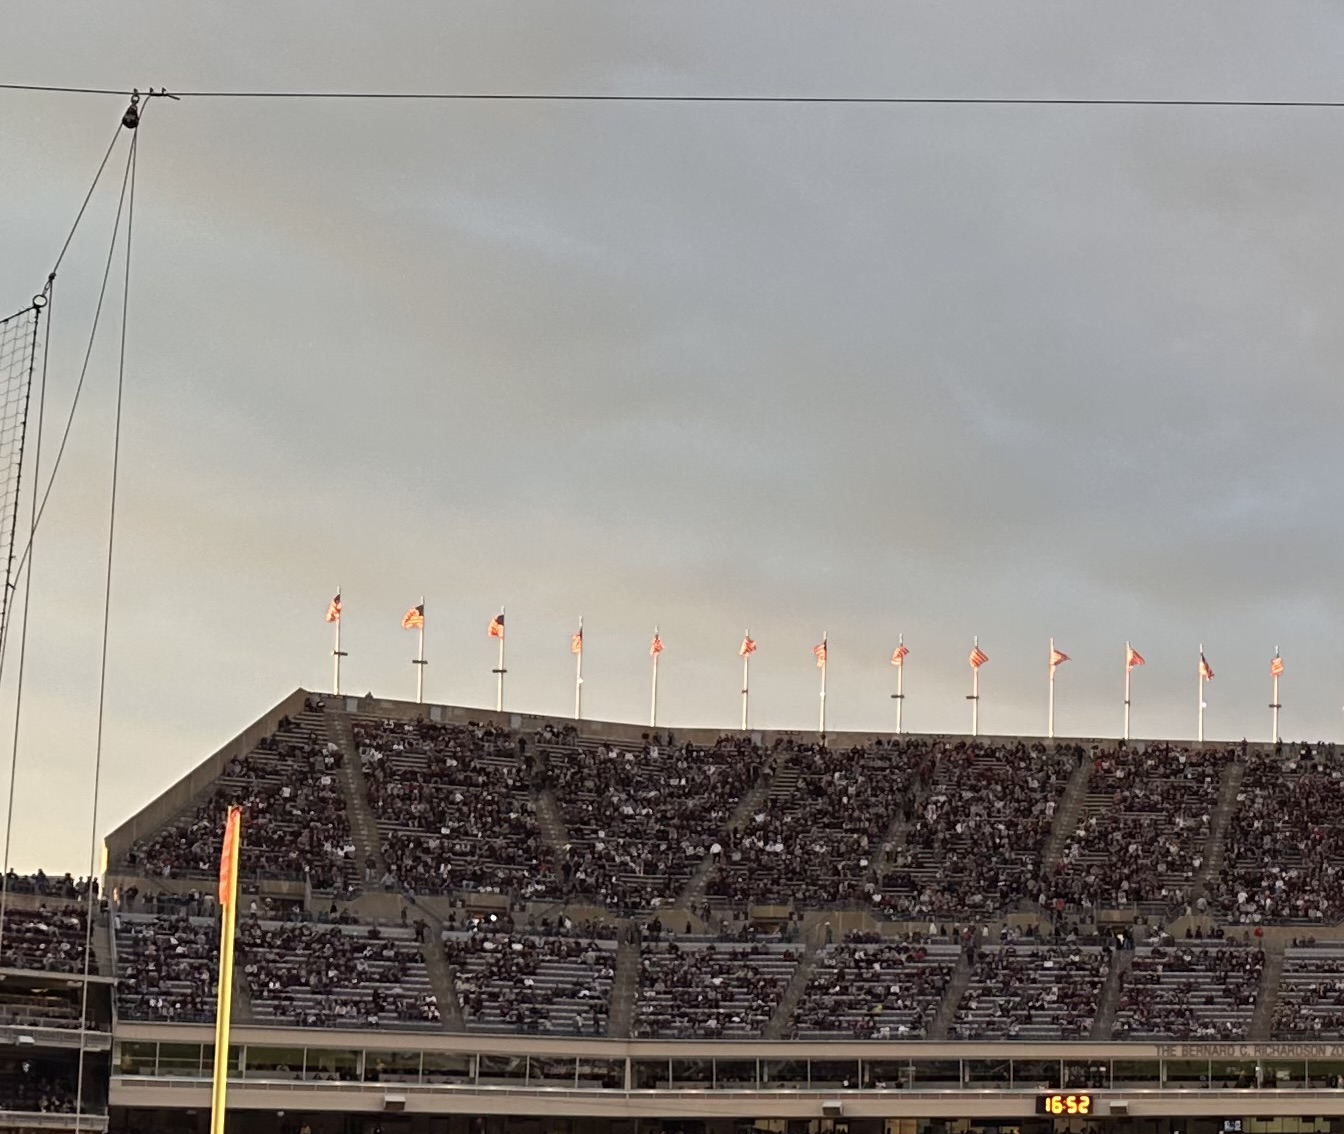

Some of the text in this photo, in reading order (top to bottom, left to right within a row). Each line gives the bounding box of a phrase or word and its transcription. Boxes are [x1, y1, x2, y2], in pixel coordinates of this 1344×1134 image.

[1155, 1044, 1178, 1057] THE
[1182, 1044, 1236, 1057] BERNARD
[1239, 1044, 1250, 1058] C.
[1254, 1044, 1327, 1058] RICHARDSON
[1045, 1096, 1091, 1114] 16:52
